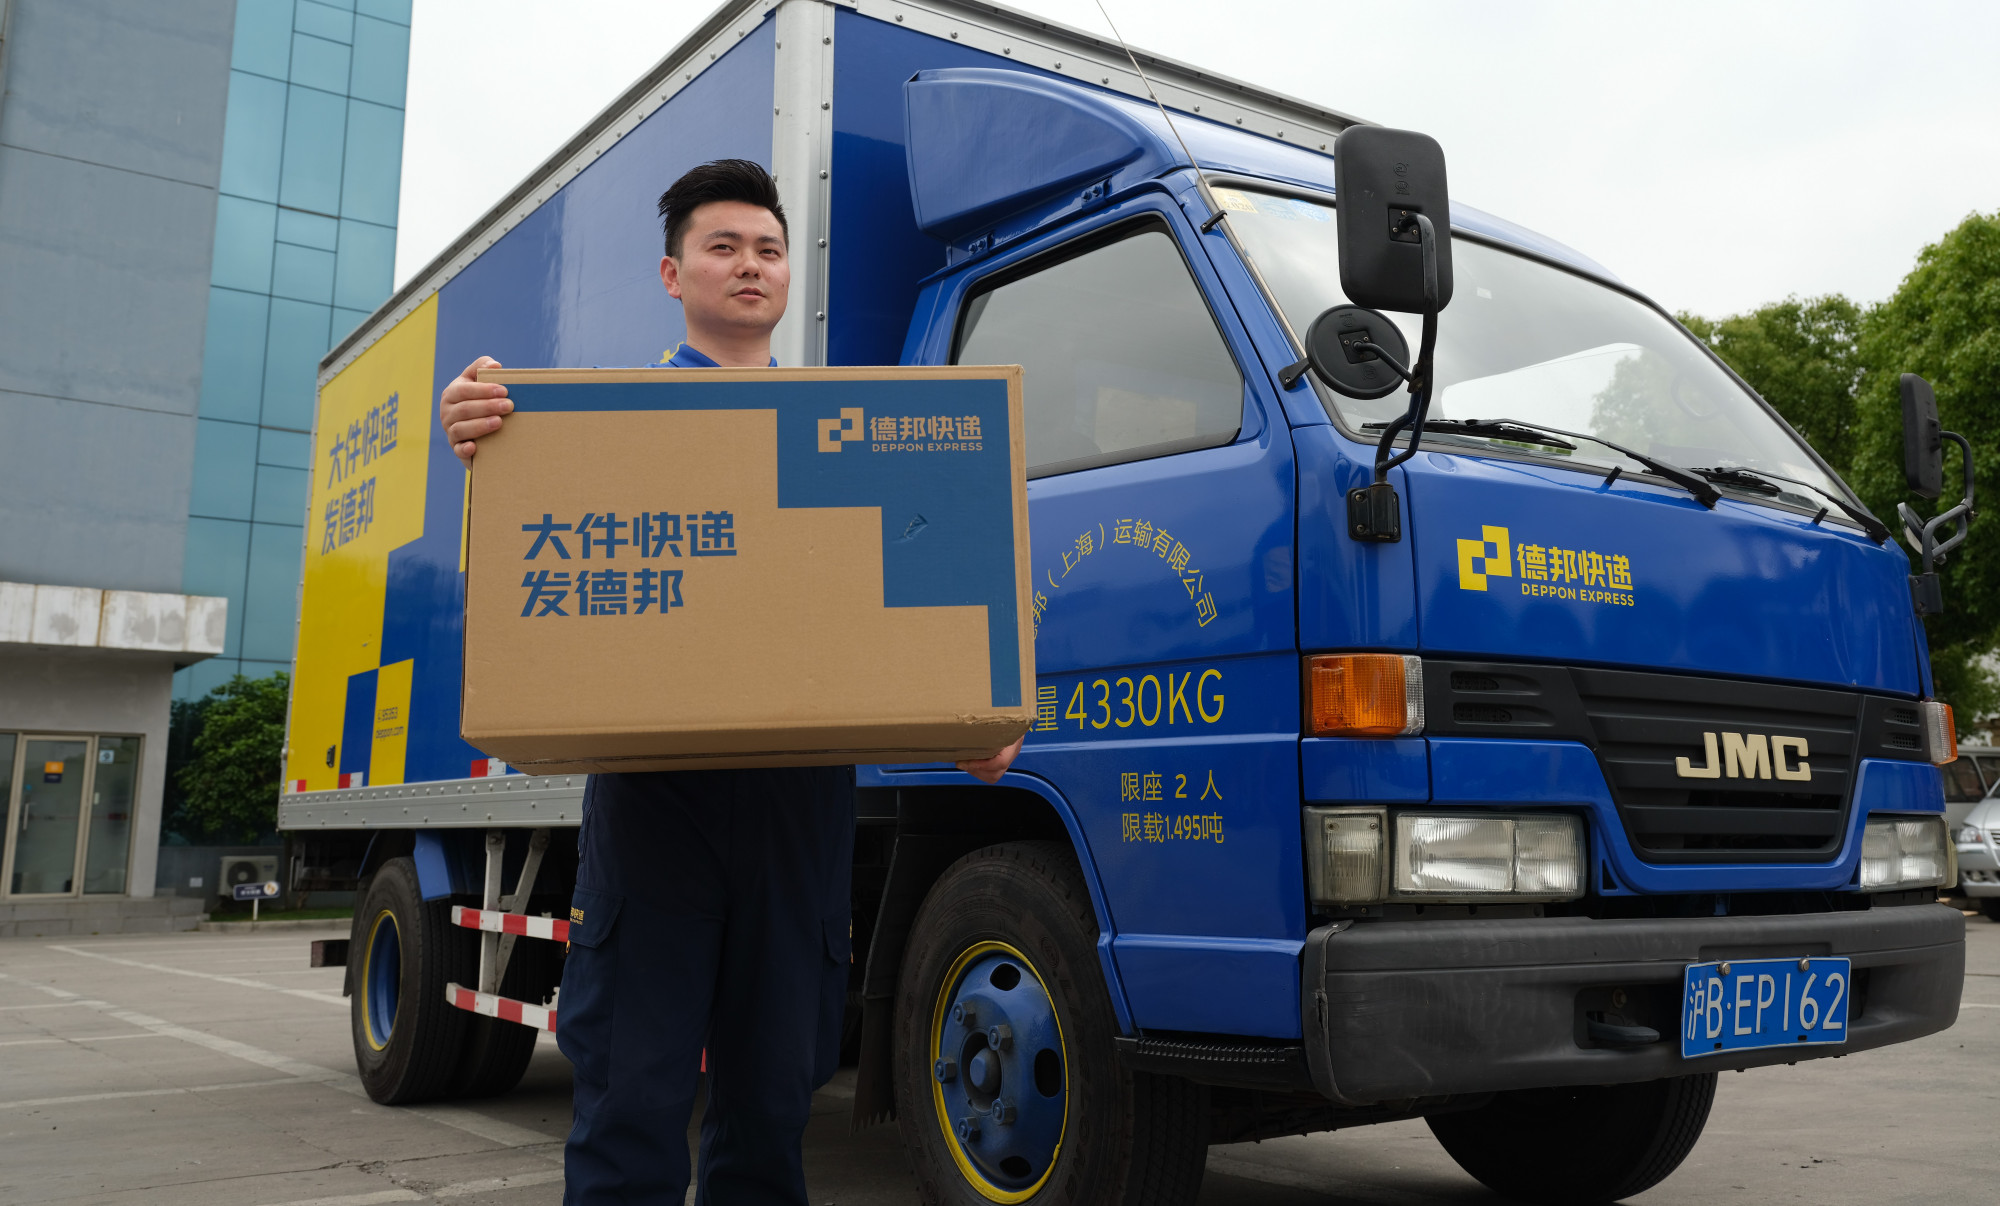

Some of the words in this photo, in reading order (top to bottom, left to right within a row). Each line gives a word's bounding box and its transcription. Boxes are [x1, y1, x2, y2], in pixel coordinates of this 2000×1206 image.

[327, 390, 399, 490] 大件快递
[869, 415, 983, 441] 德邦快递
[872, 443, 924, 452] DEPPON
[928, 442, 983, 452] EXPRESS
[321, 476, 377, 556] 发德邦
[521, 510, 737, 560] 大件快递
[1516, 543, 1633, 591] 德邦快递
[520, 568, 684, 617] 发德邦
[1521, 583, 1576, 600] DEPPON
[1580, 589, 1635, 607] EXPRESS
[1675, 731, 1812, 781] JMC
[1121, 771, 1163, 802] 限座
[1174, 773, 1188, 799] 2
[1200, 769, 1223, 801] 人
[1122, 811, 1225, 844] 限载1.495吨
[1686, 972, 1846, 1041] 沪B·EP162
